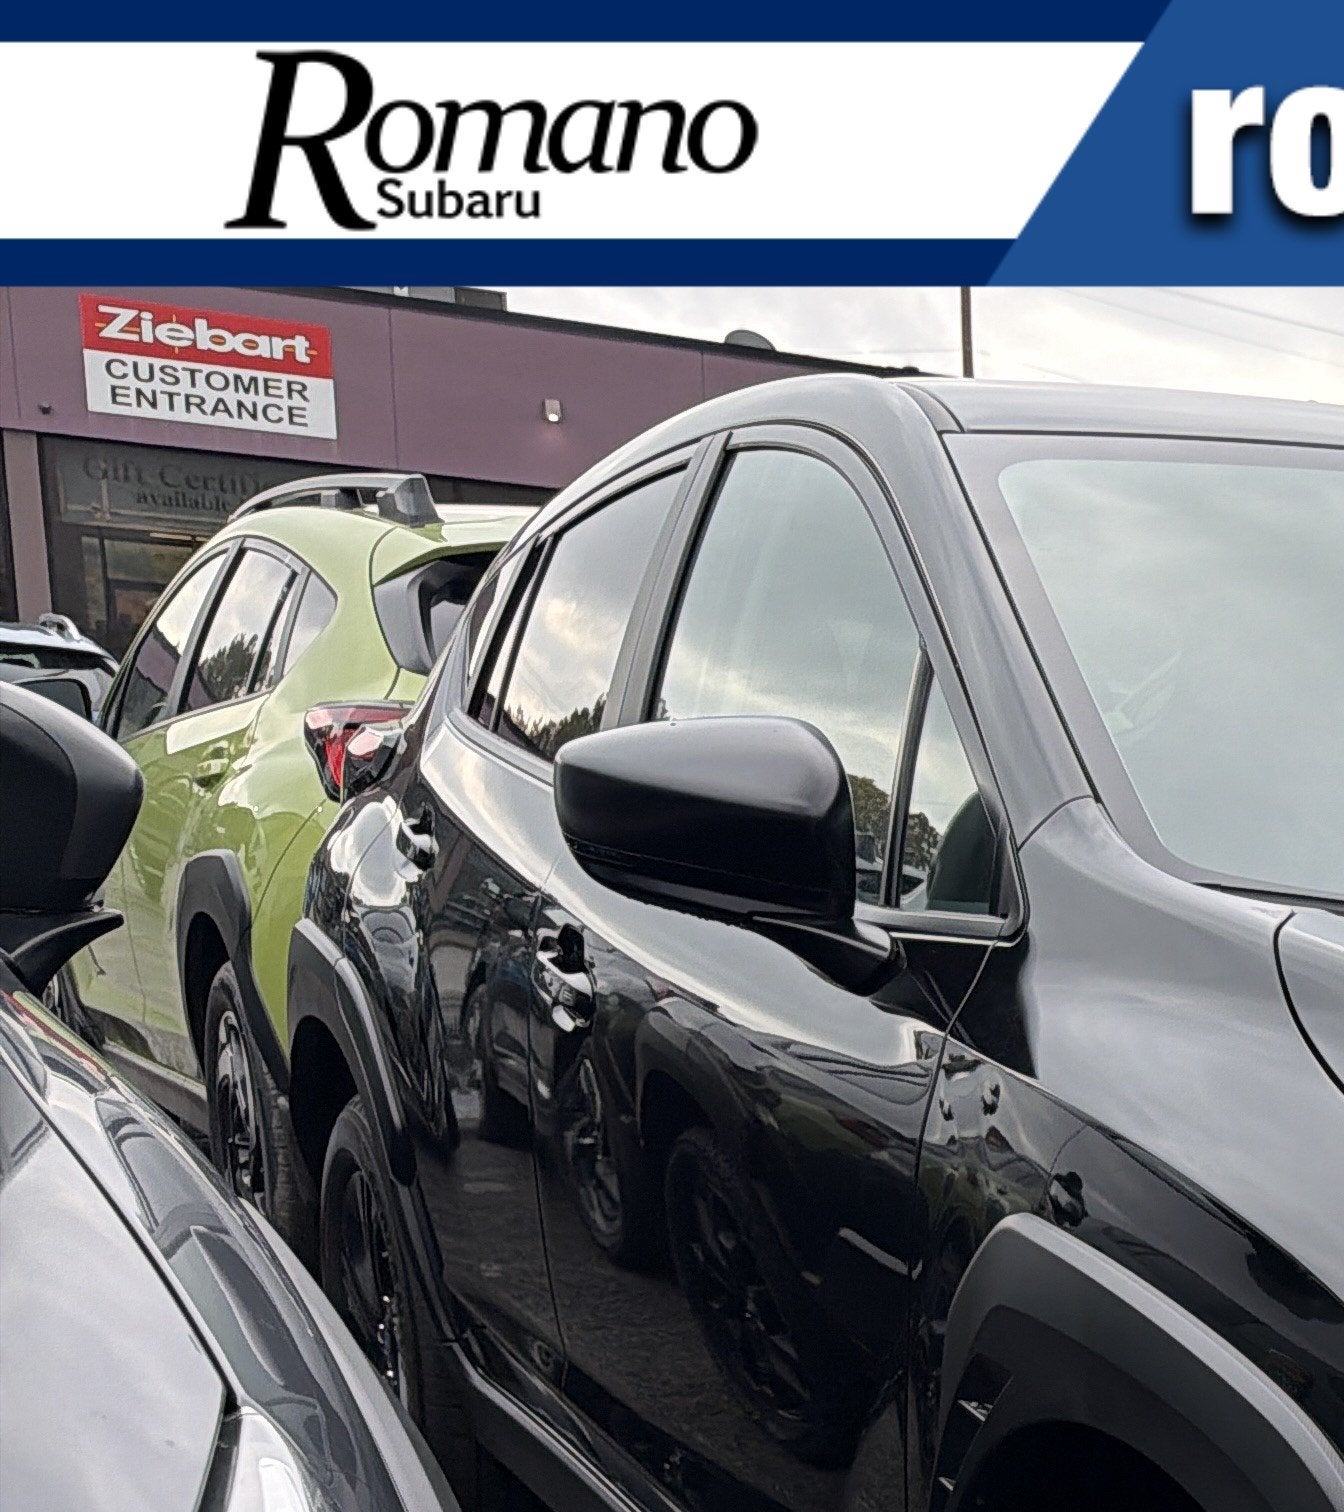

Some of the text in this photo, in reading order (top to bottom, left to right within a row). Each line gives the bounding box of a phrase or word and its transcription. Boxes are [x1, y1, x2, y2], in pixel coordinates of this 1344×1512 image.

[98, 304, 311, 364] Ziebart
[105, 359, 310, 402] CUSTOMER
[110, 384, 308, 427] ENTRANCE
